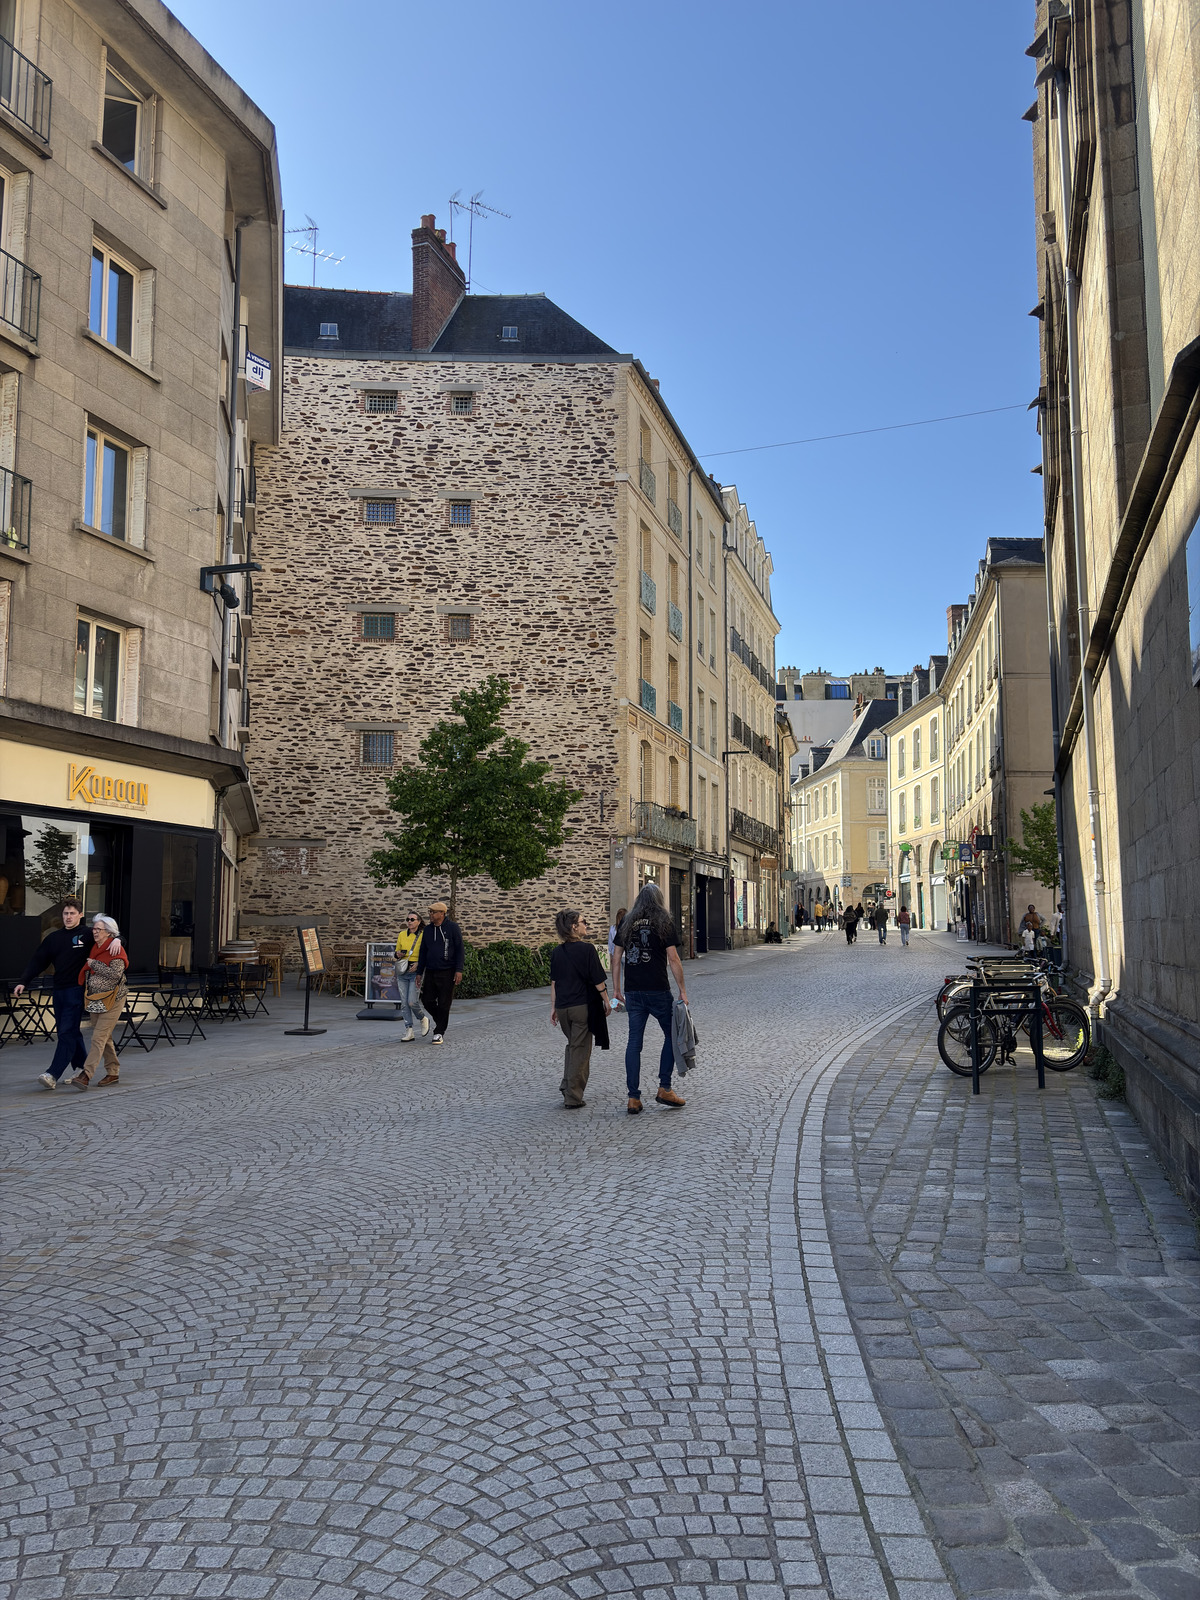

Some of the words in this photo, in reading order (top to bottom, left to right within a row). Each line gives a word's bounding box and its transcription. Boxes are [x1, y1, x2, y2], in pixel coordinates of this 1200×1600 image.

[252, 355, 270, 368] VENDRE
[252, 366, 264, 380] dlj
[68, 763, 149, 805] KOBOON
[381, 990, 388, 998] K
